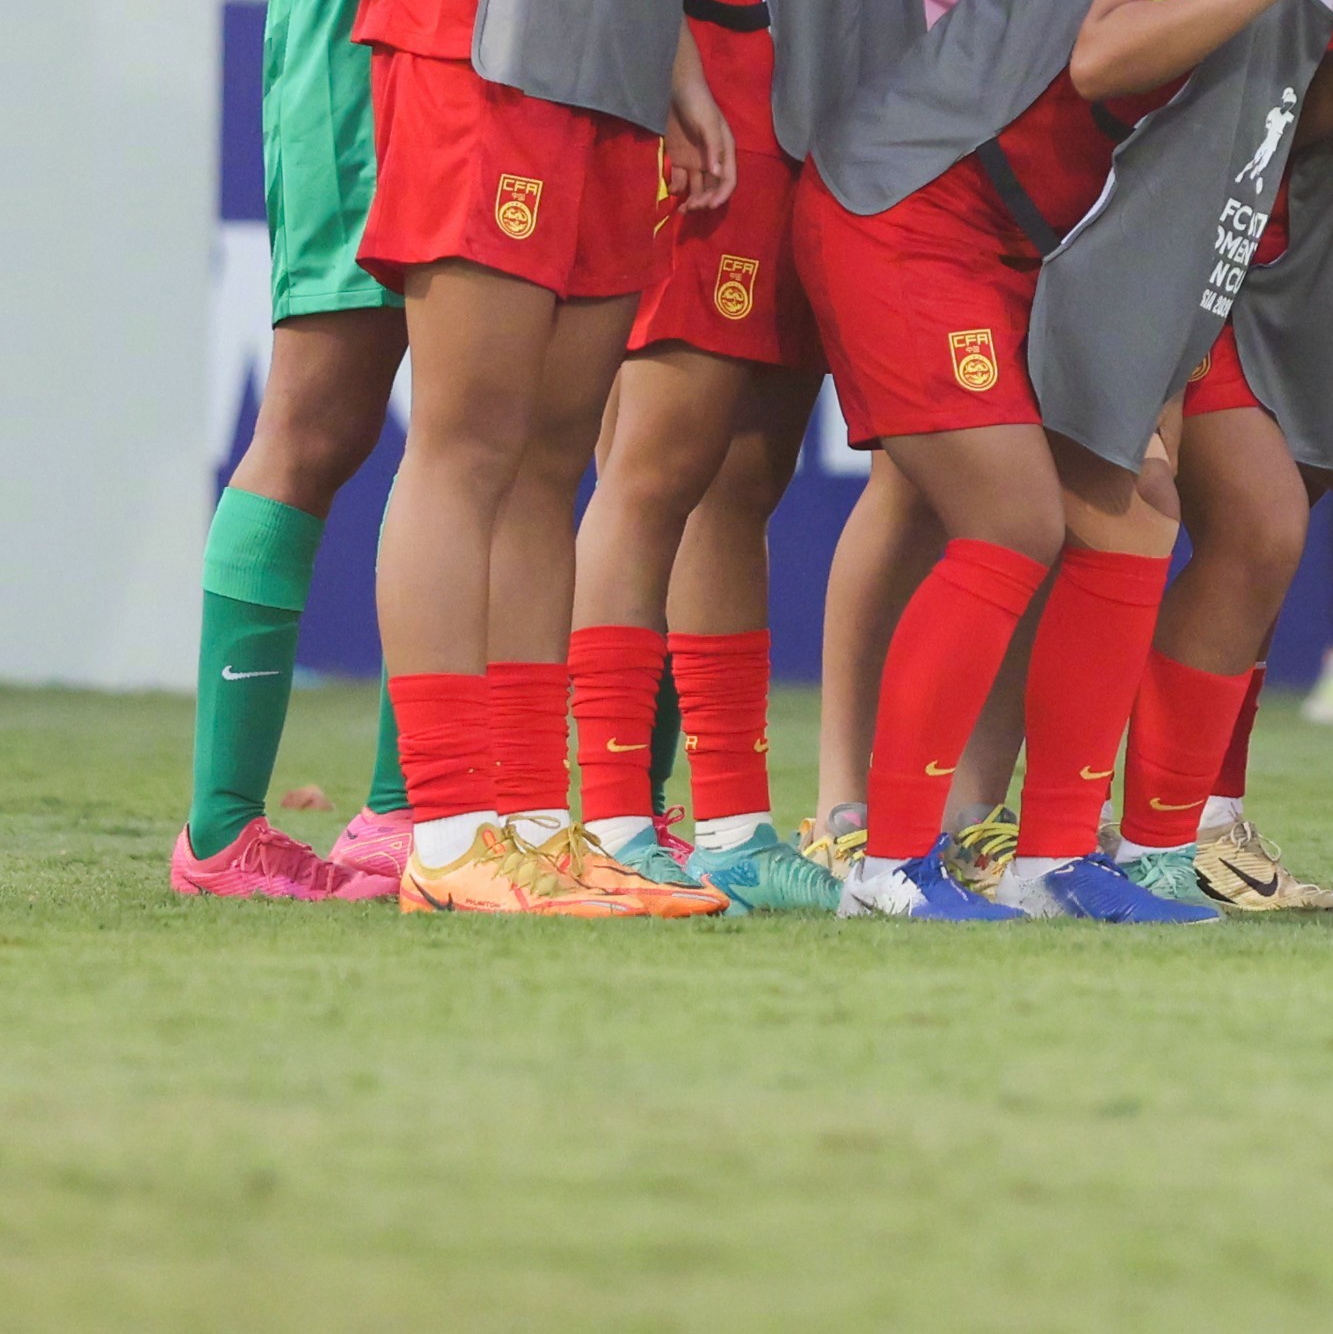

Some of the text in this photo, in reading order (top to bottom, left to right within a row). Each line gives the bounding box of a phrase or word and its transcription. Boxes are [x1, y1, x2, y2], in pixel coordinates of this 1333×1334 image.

[502, 178, 539, 196] CFA
[1219, 197, 1253, 231] FC
[723, 259, 755, 275] CFA
[953, 333, 989, 348] CFA
